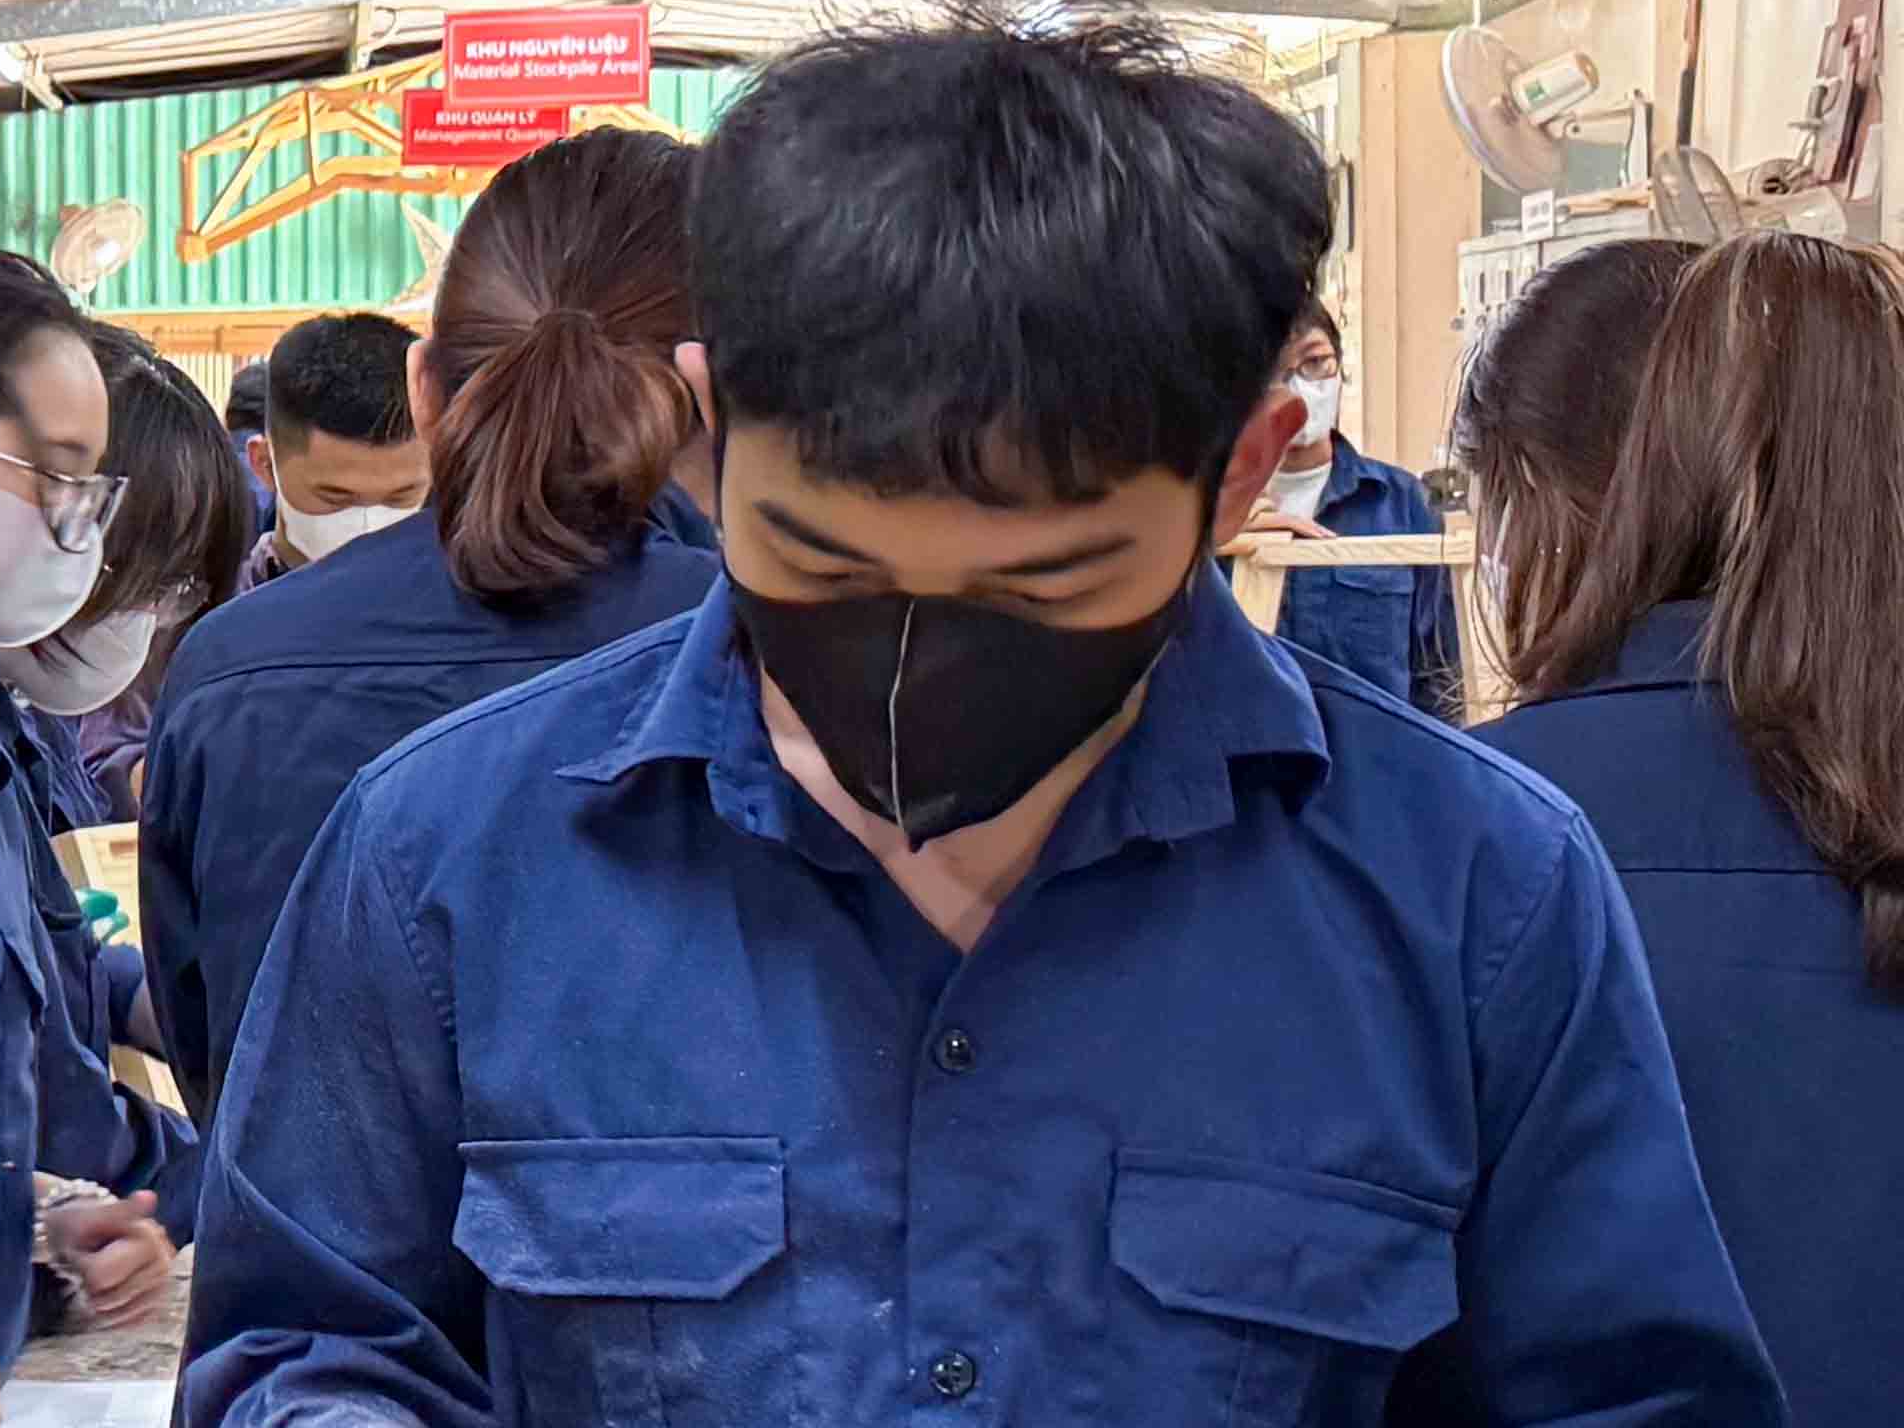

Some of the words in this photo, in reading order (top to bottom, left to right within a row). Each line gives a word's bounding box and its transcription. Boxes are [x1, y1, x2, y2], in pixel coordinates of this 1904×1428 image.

[466, 41, 507, 60] KHU
[453, 61, 521, 79] Material
[601, 58, 641, 76] Area
